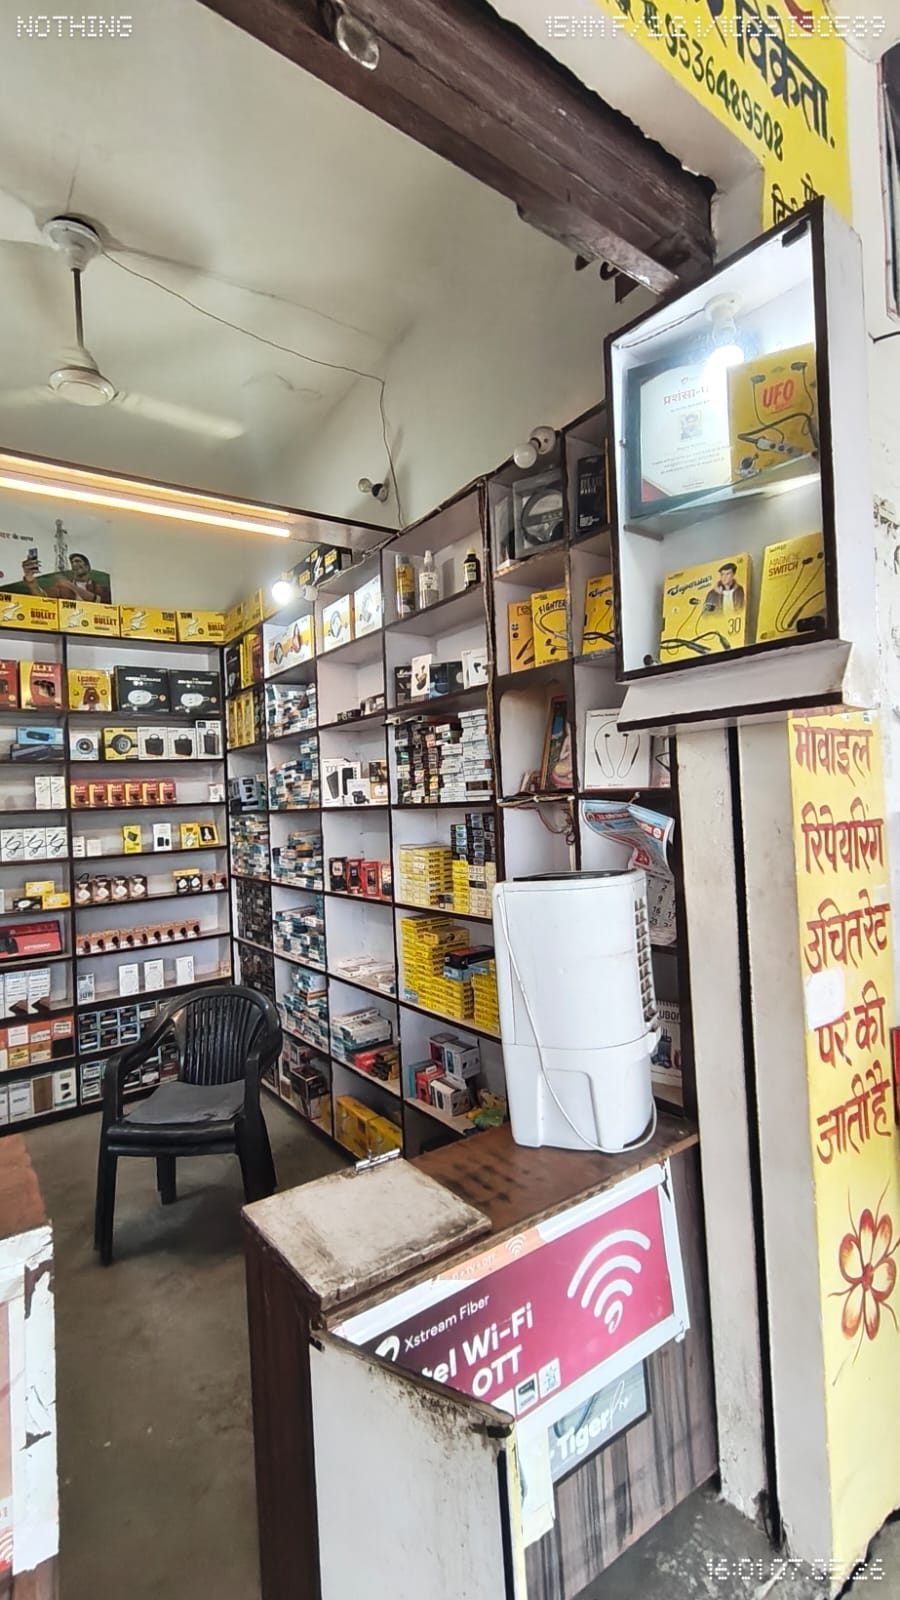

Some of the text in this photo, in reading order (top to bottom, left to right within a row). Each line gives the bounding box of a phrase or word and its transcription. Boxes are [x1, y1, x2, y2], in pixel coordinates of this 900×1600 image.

[664, 13, 783, 162] 9536489508
[763, 379, 794, 408] UFO
[768, 561, 799, 577] SWITCH
[728, 617, 742, 636] 30
[814, 980, 886, 1069] पर की
[404, 1296, 489, 1352] Xstream Fiber
[462, 1302, 533, 1367] Wi-Fi
[472, 1344, 523, 1397] OTT
[557, 1409, 609, 1460] Tiger
